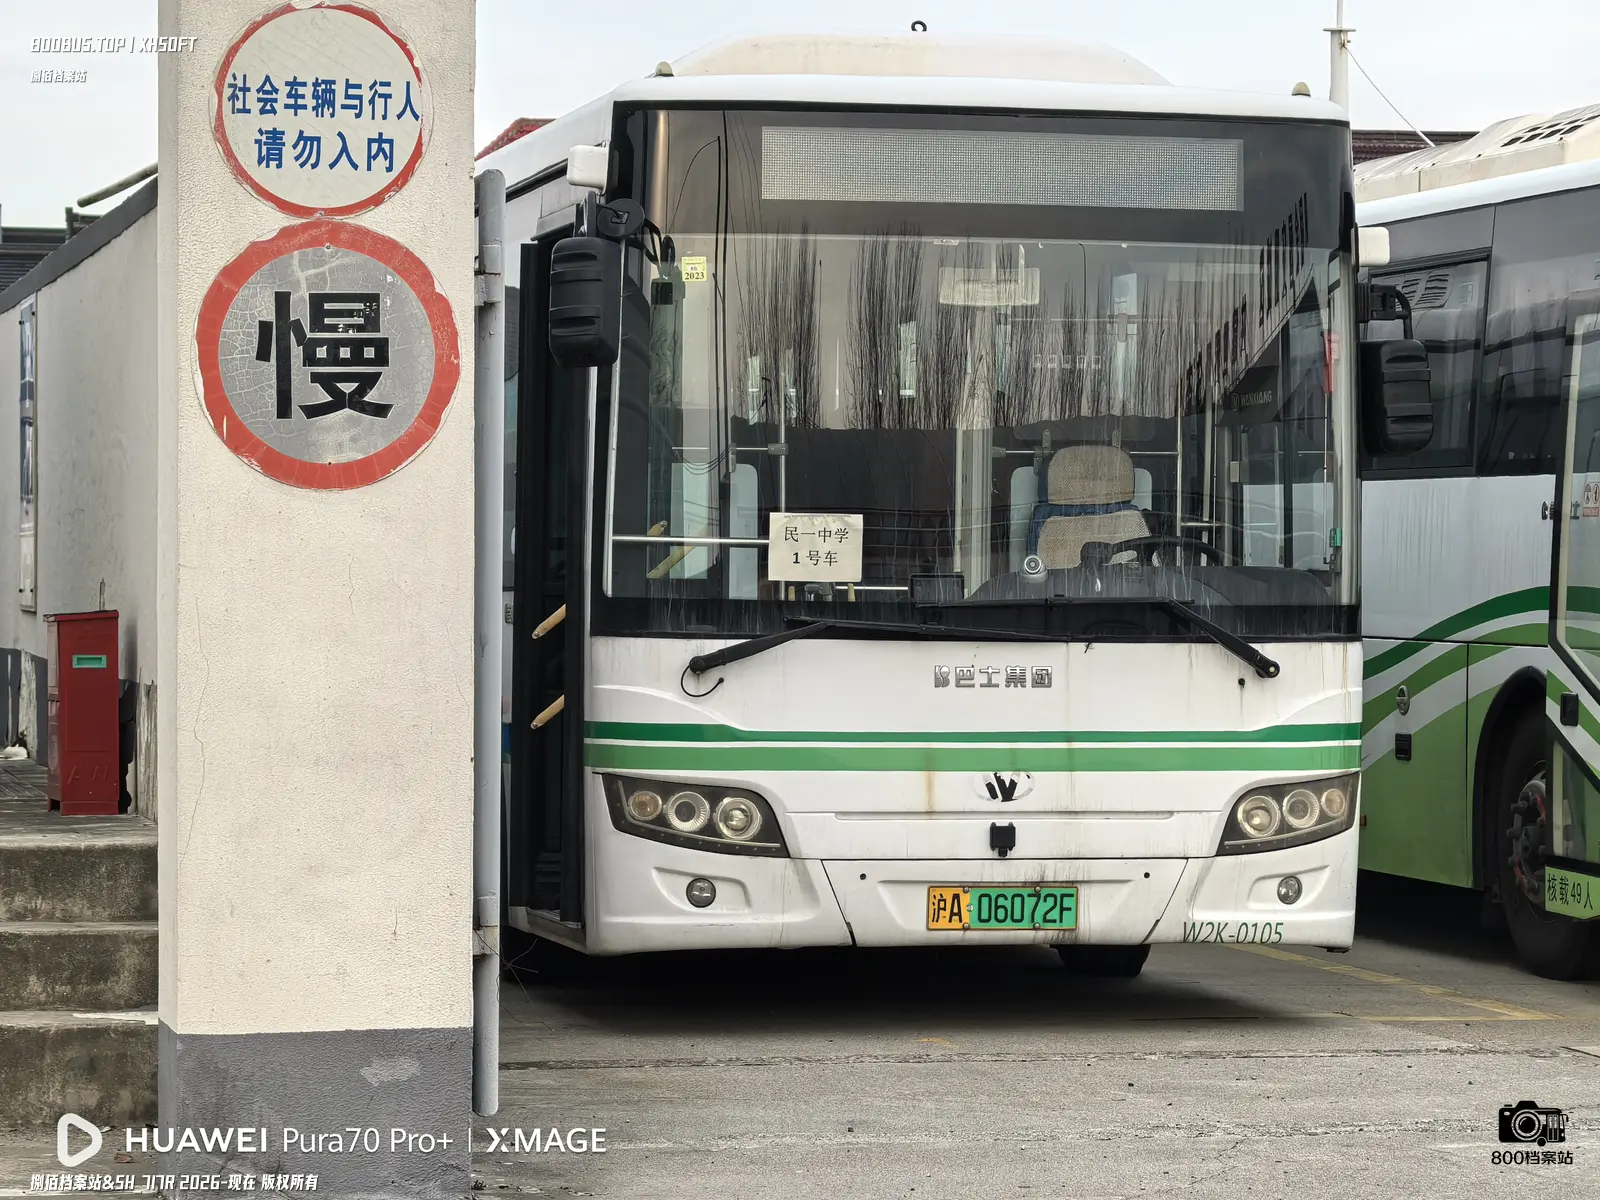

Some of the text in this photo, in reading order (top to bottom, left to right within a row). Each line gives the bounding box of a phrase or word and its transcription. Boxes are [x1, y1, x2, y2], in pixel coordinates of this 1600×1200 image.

[227, 72, 420, 121] 社会车辆与行人
[254, 127, 395, 173] 请勿入内
[684, 272, 705, 280] 2023
[255, 291, 395, 420] 慢
[784, 526, 849, 543] 民一中学
[955, 665, 1052, 688] 巴士集团
[1183, 921, 1284, 943] W2K-0105
